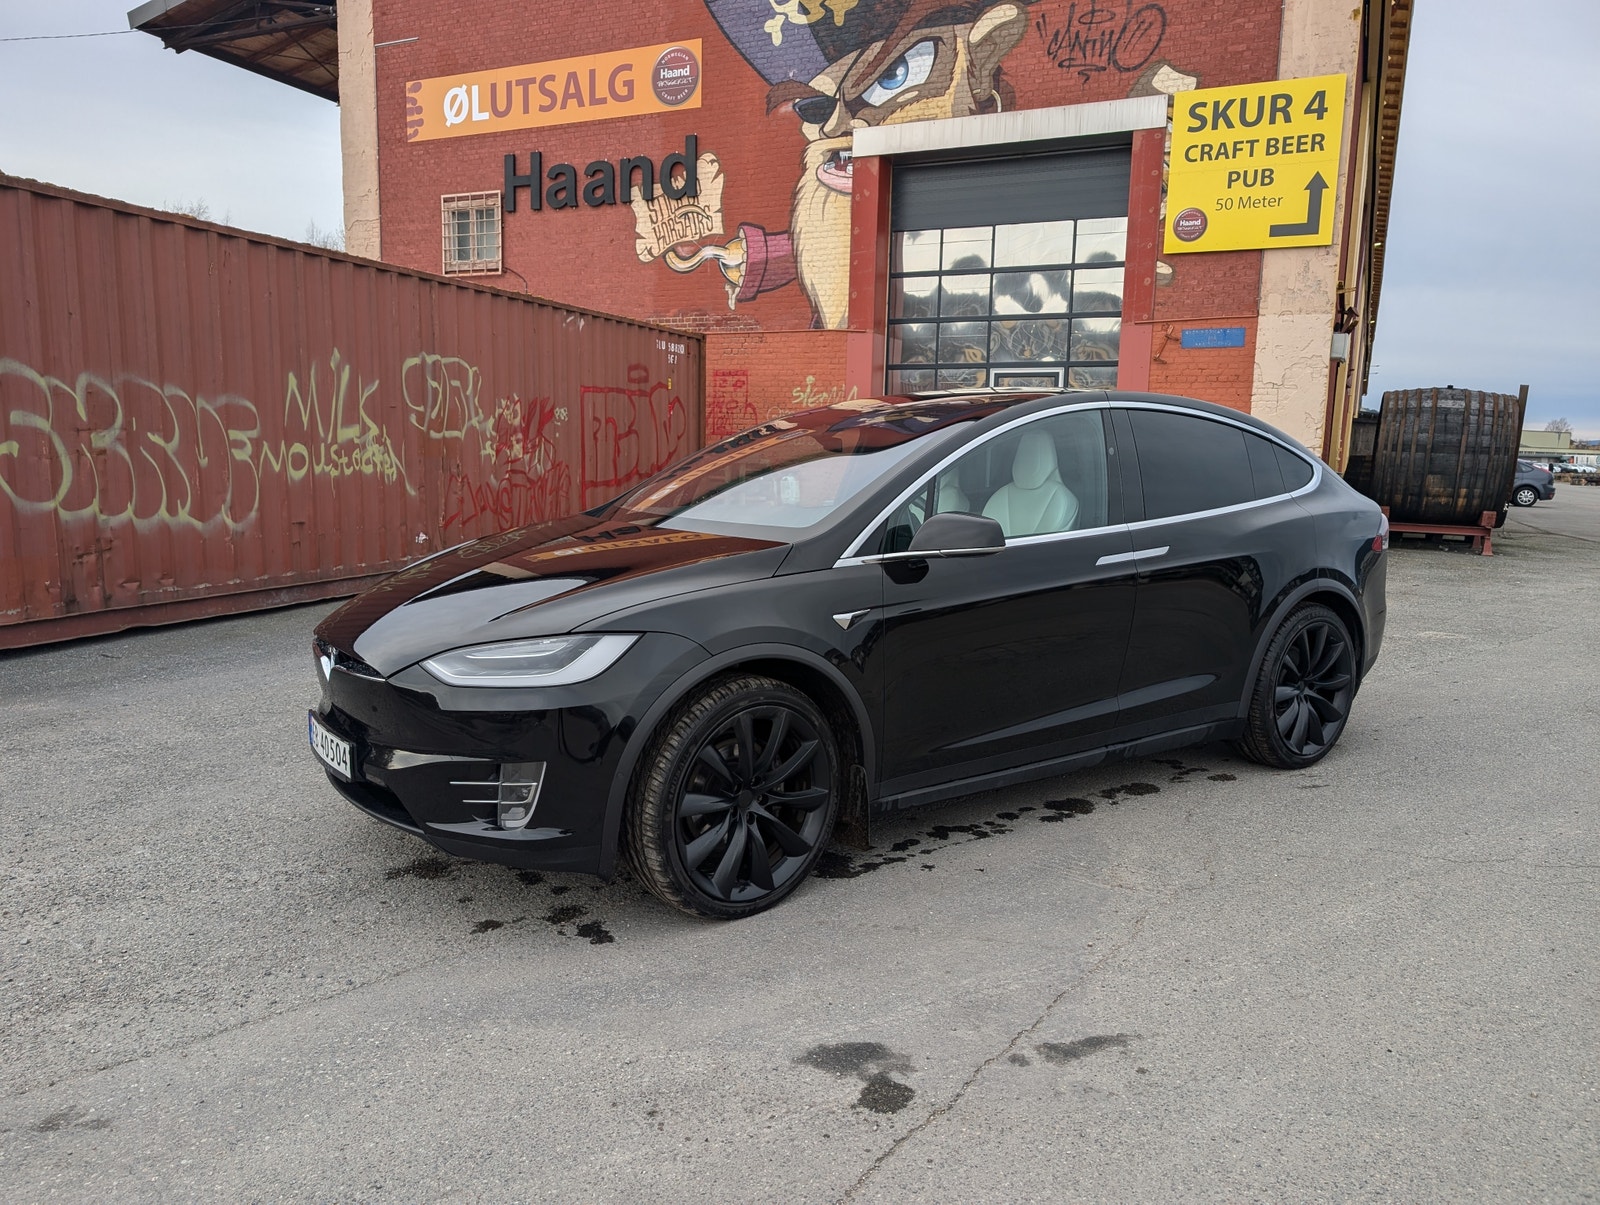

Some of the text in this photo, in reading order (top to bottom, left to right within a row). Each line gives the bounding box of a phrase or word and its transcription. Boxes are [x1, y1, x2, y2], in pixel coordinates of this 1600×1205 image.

[660, 64, 690, 79] Haand
[443, 63, 635, 128] ØLUTSALG
[1187, 90, 1329, 133] SKUR 4
[1184, 133, 1326, 163] CRAFT BEER
[504, 134, 698, 214] Haand
[1227, 168, 1275, 189] PUB
[1215, 195, 1284, 212] 50 Meter
[1180, 218, 1202, 227] Haand
